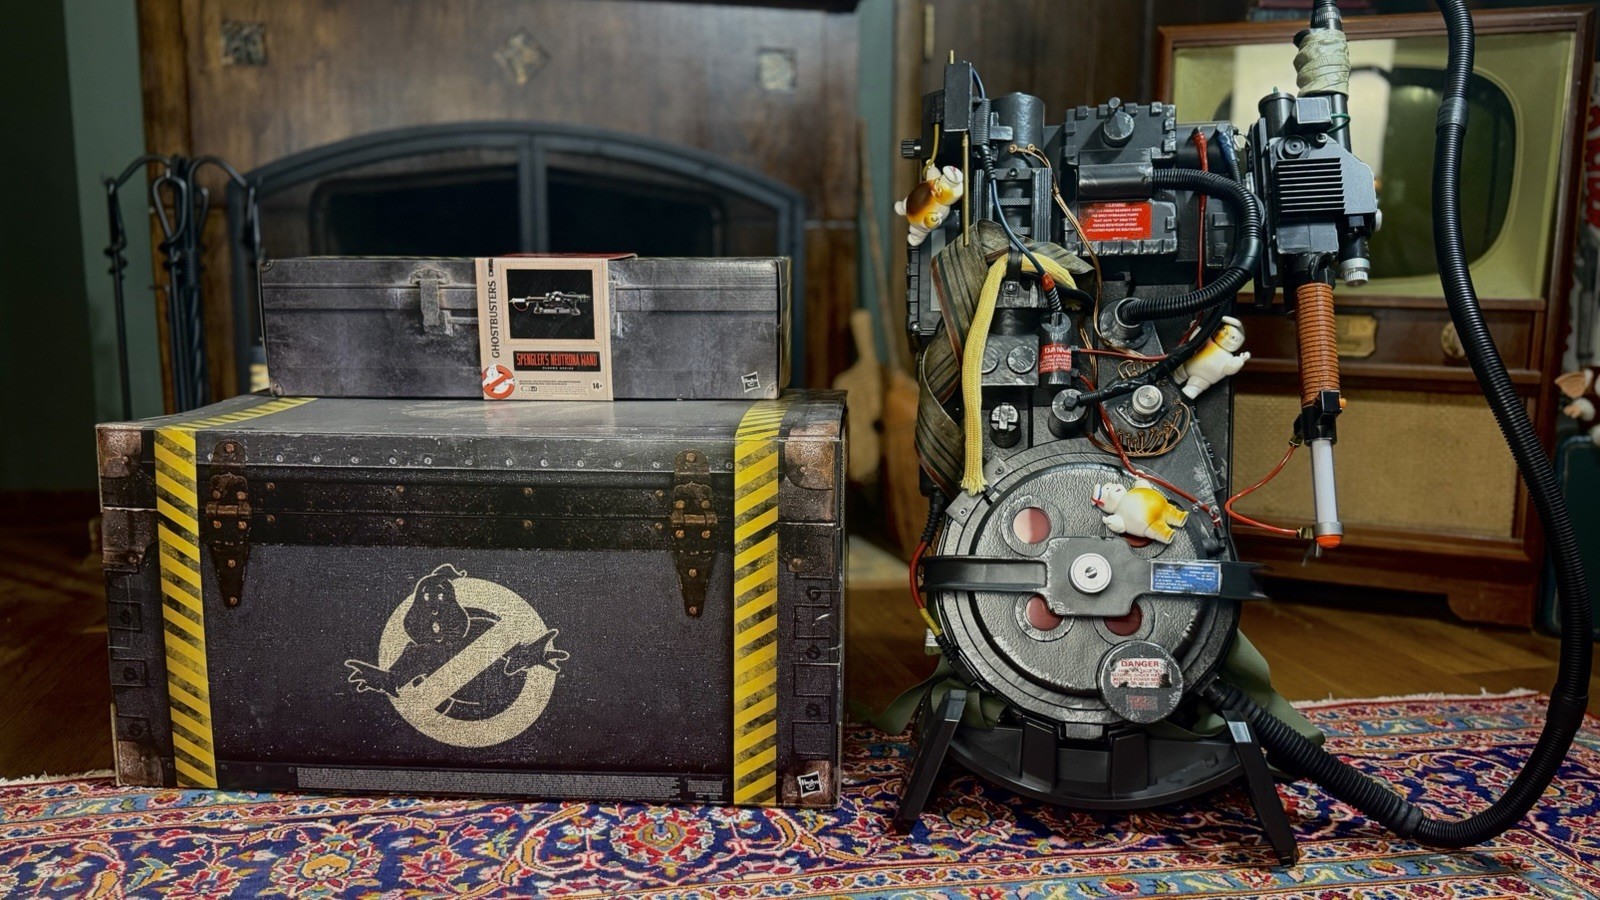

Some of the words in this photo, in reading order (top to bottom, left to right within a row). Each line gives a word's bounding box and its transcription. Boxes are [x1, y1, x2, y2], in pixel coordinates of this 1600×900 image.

[488, 280, 500, 358] GHOSTBUSTERS
[516, 352, 549, 366] SPENGLER'S
[550, 353, 580, 366] NEUTRONA
[581, 354, 598, 366] WAND
